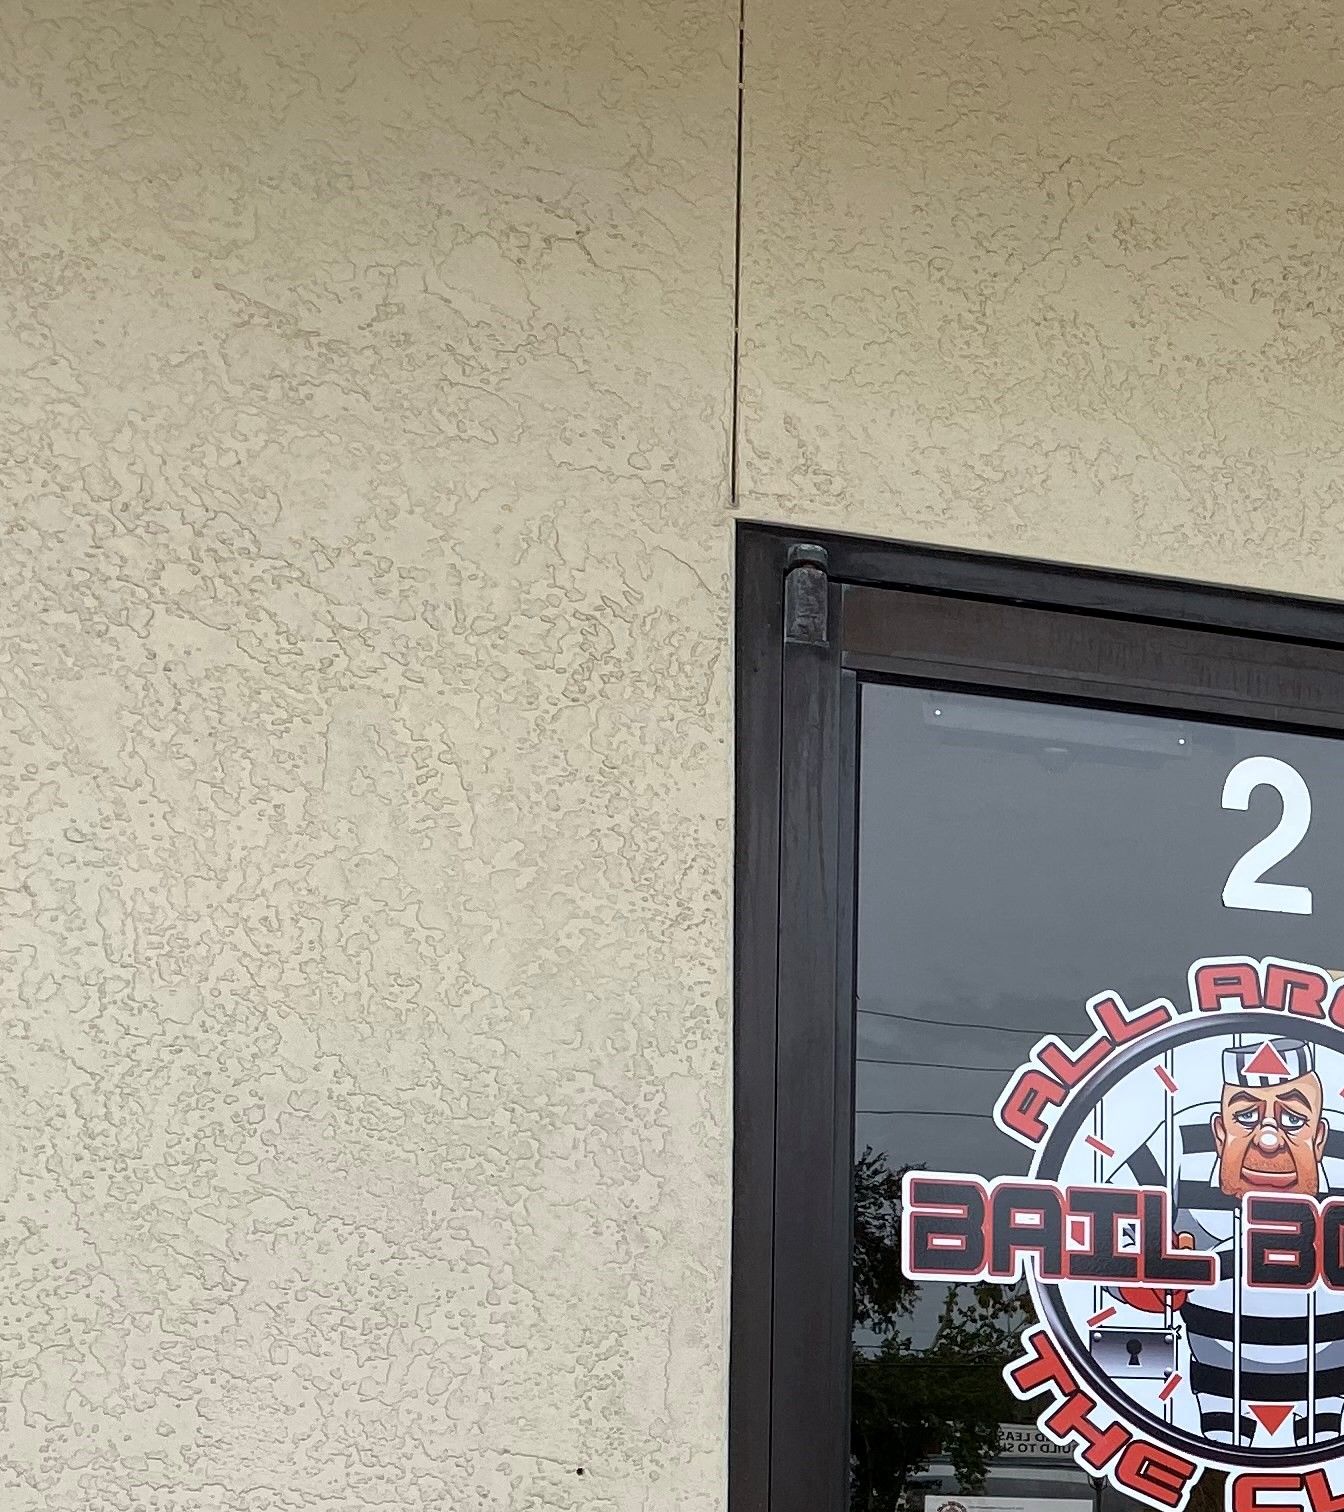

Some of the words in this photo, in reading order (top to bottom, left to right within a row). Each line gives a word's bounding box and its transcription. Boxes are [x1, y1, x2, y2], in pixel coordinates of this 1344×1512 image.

[1221, 756, 1313, 915] 2
[994, 991, 1172, 1148] ALL
[902, 1171, 1219, 1287] BAIL
